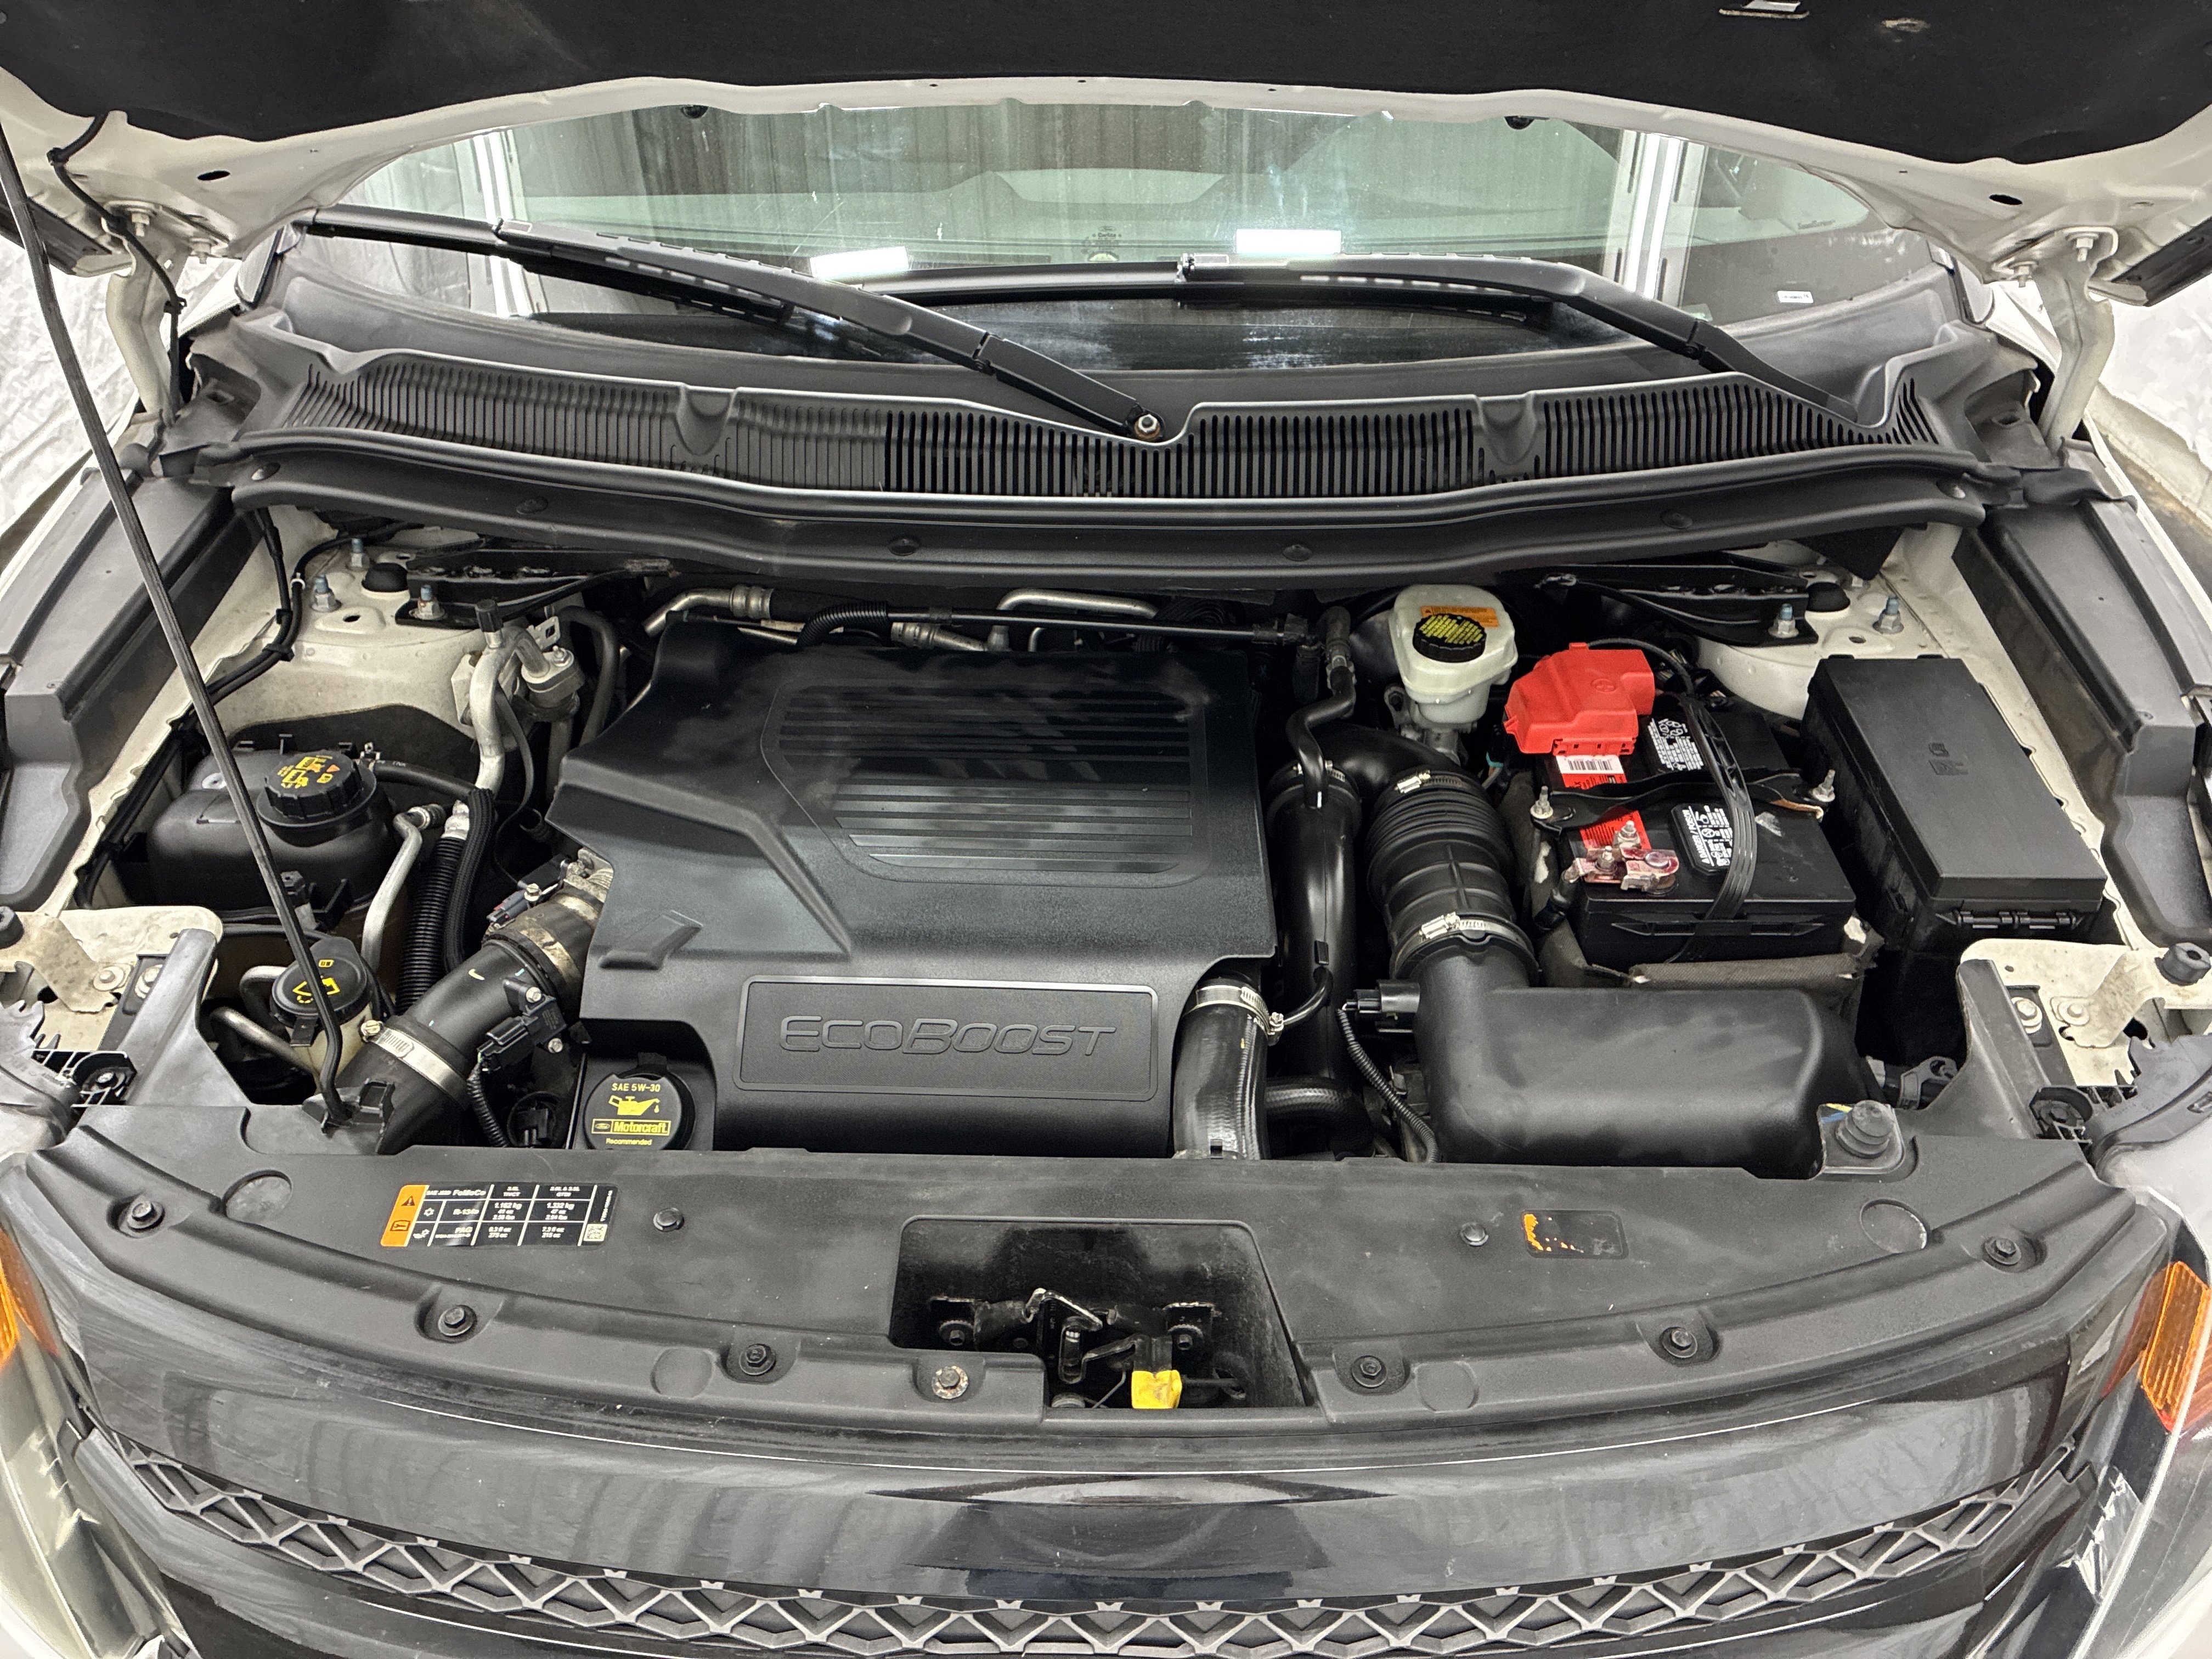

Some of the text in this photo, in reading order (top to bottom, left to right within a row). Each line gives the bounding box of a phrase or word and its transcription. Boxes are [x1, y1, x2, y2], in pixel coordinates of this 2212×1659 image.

[612, 1083, 661, 1092] SAE 5W-30
[613, 1121, 667, 1133] Motorcraft
